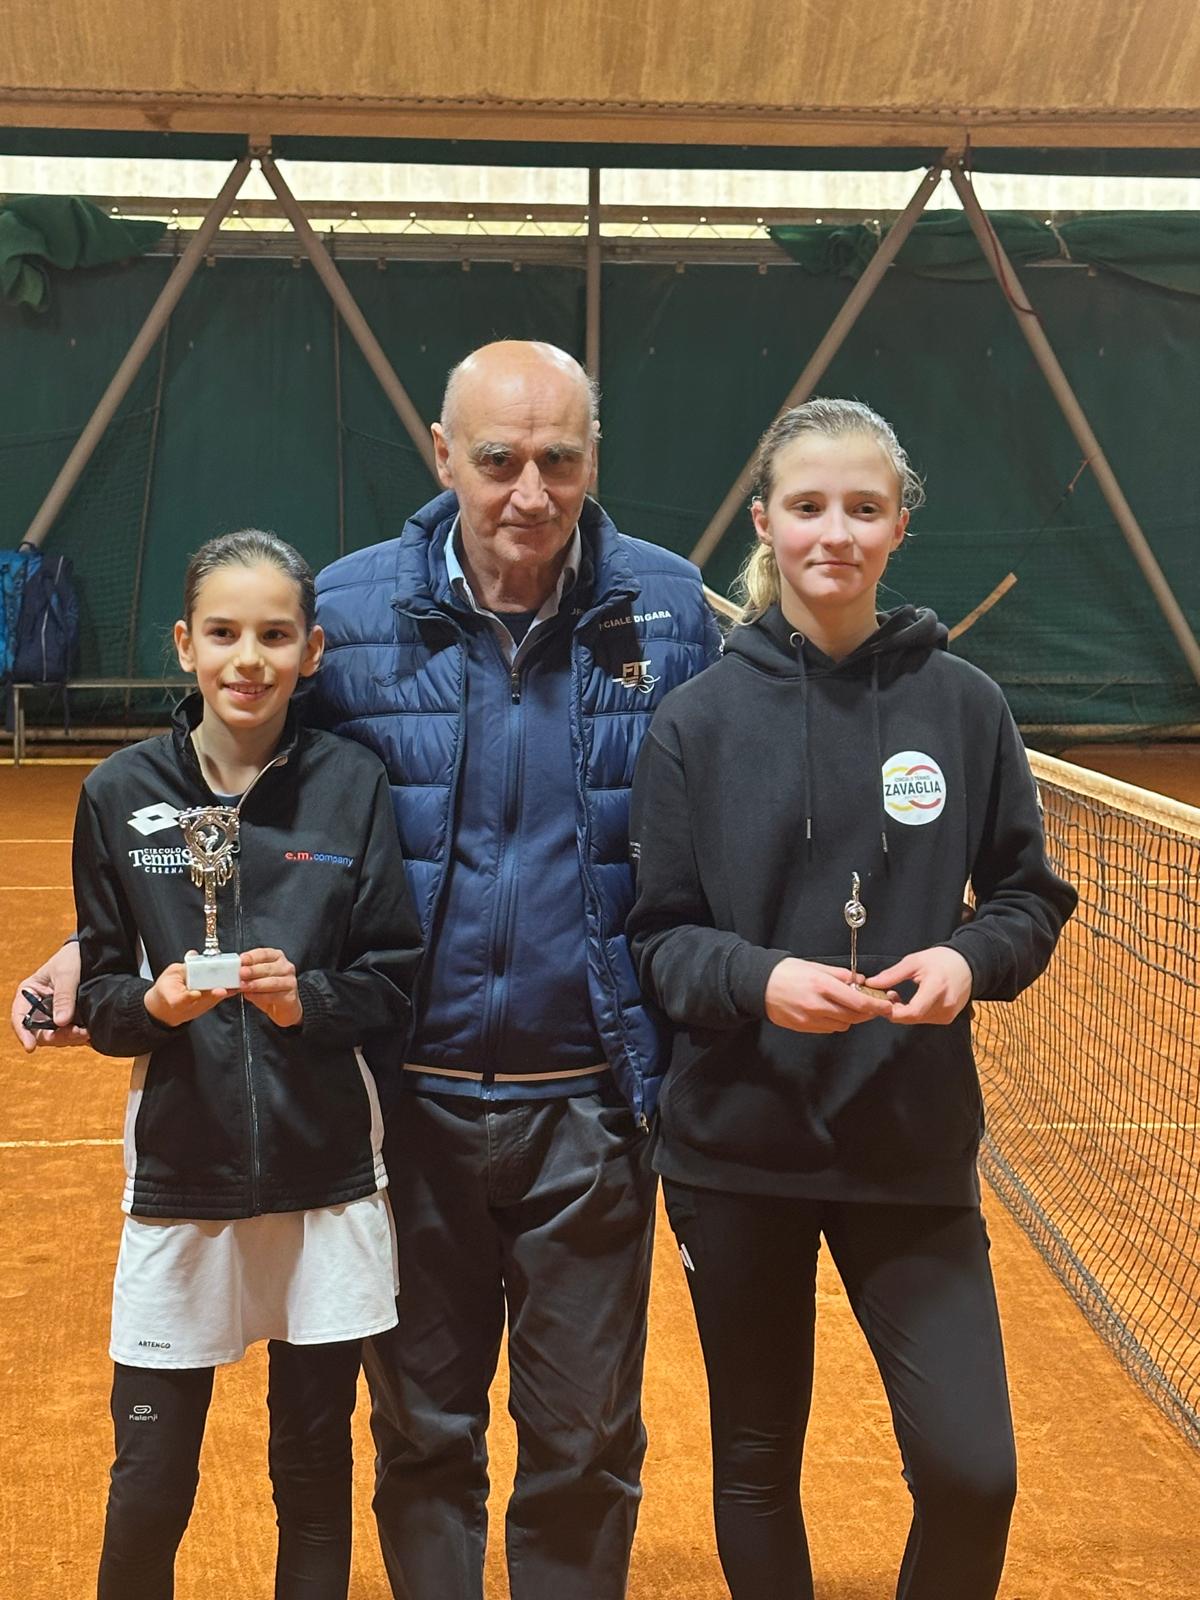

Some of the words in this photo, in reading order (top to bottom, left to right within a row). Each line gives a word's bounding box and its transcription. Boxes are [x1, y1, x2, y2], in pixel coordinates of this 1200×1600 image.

[633, 615, 645, 623] DI
[644, 610, 672, 621] GARA
[622, 660, 651, 677] FIT
[885, 780, 942, 797] ZAVAGLIA
